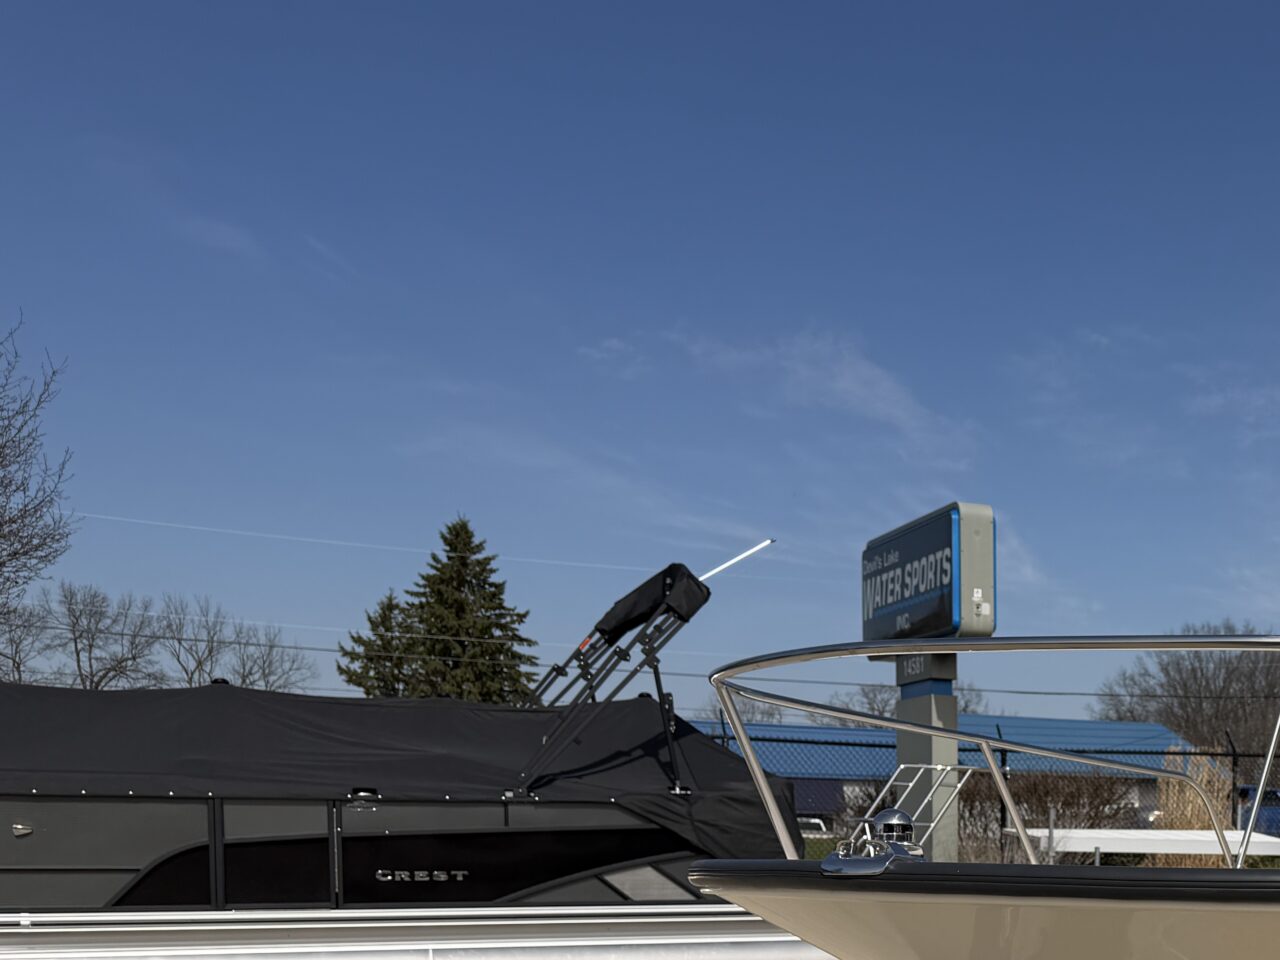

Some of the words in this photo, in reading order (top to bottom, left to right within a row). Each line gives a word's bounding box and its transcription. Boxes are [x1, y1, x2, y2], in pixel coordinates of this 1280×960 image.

[863, 567, 902, 620] WATER
[904, 547, 951, 598] SPORTS
[376, 869, 470, 881] CREST
